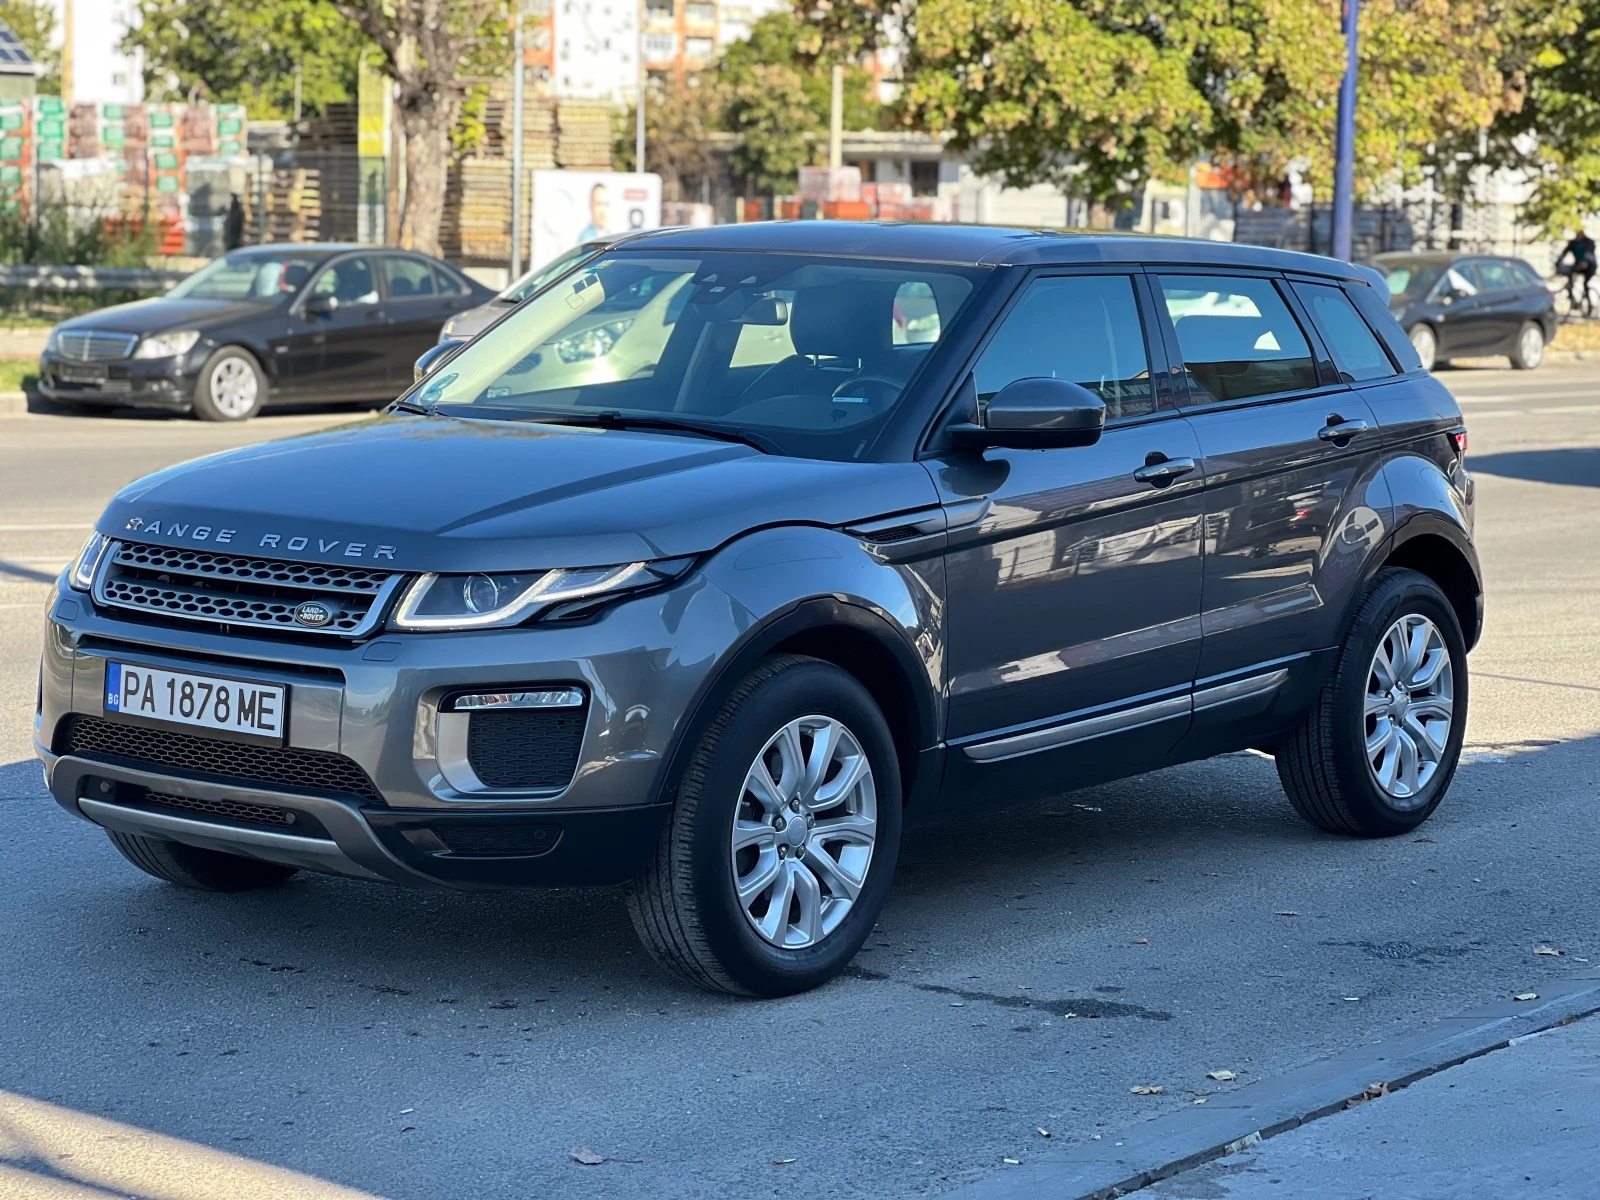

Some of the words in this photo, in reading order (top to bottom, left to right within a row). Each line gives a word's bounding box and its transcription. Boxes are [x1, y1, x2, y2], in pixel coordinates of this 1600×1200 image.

[125, 516, 236, 543] RANGE
[259, 533, 398, 560] ROVER
[302, 606, 320, 614] LAND
[302, 612, 324, 621] ROVER
[107, 693, 119, 705] BG
[123, 670, 156, 713] PA
[166, 678, 230, 723] 1878
[237, 688, 276, 731] ME
